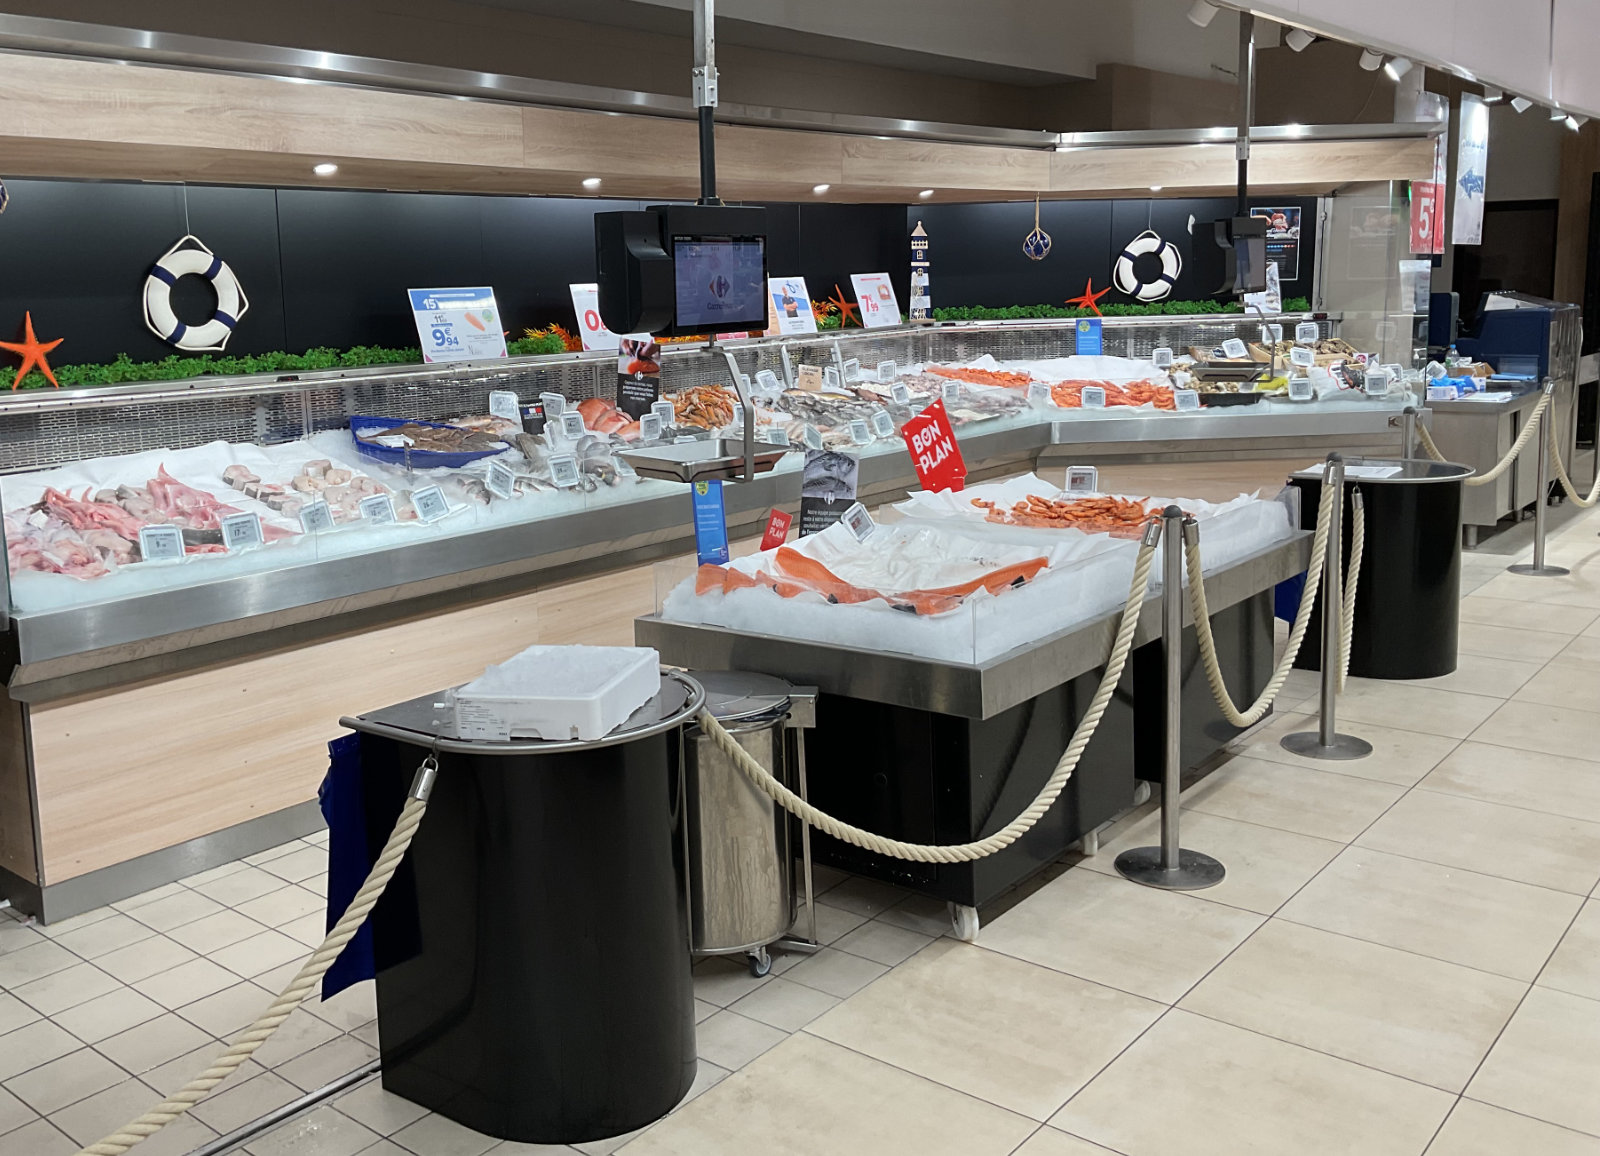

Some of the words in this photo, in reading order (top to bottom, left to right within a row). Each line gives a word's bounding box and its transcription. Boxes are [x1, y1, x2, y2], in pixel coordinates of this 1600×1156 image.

[912, 419, 941, 454] BON
[919, 435, 954, 475] PLAN
[769, 526, 785, 540] PLAN
[771, 516, 785, 529] BON
